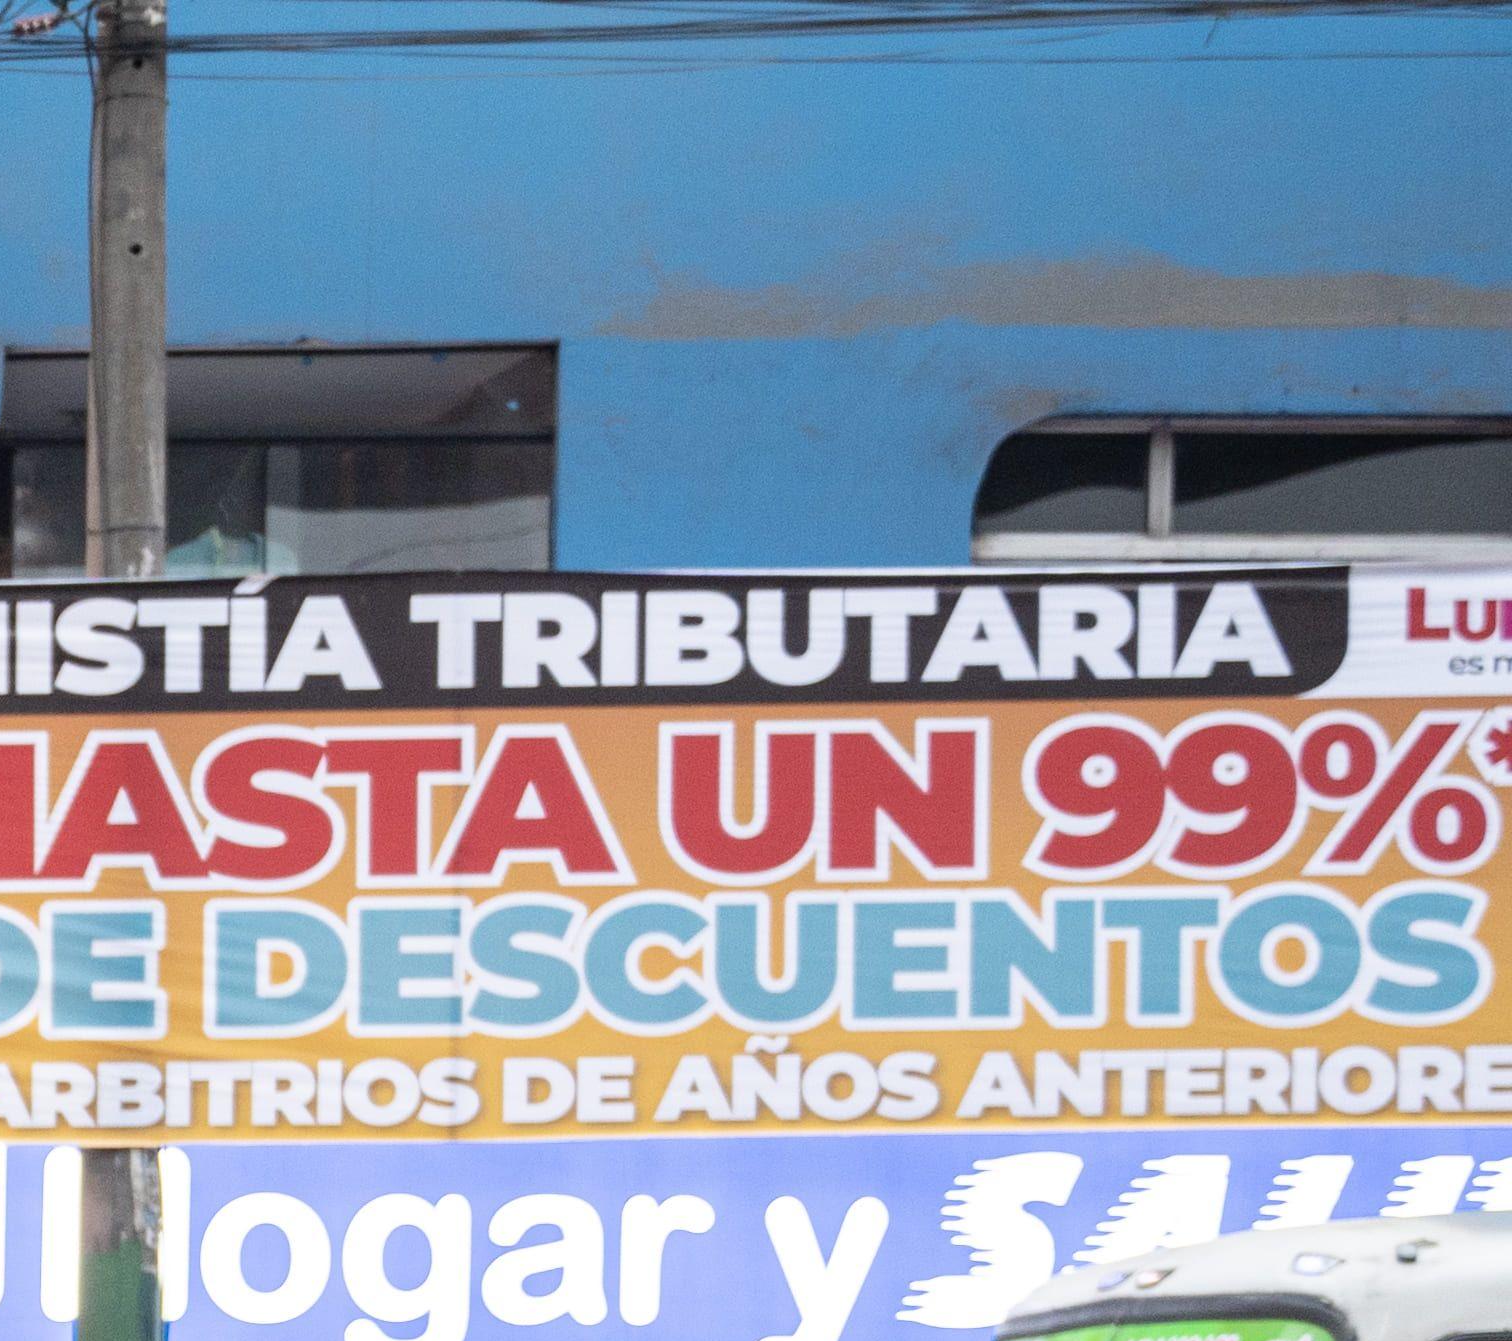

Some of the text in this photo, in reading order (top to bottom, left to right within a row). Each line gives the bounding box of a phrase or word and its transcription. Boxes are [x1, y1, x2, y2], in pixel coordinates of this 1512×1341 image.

[408, 580, 1294, 694] TRIBUTARIA
[1448, 655, 1485, 676] es
[659, 716, 991, 884] UN
[201, 877, 1494, 1042] DESCUENTOS
[500, 1056, 638, 1126] DE
[654, 1036, 942, 1124] AÑOS
